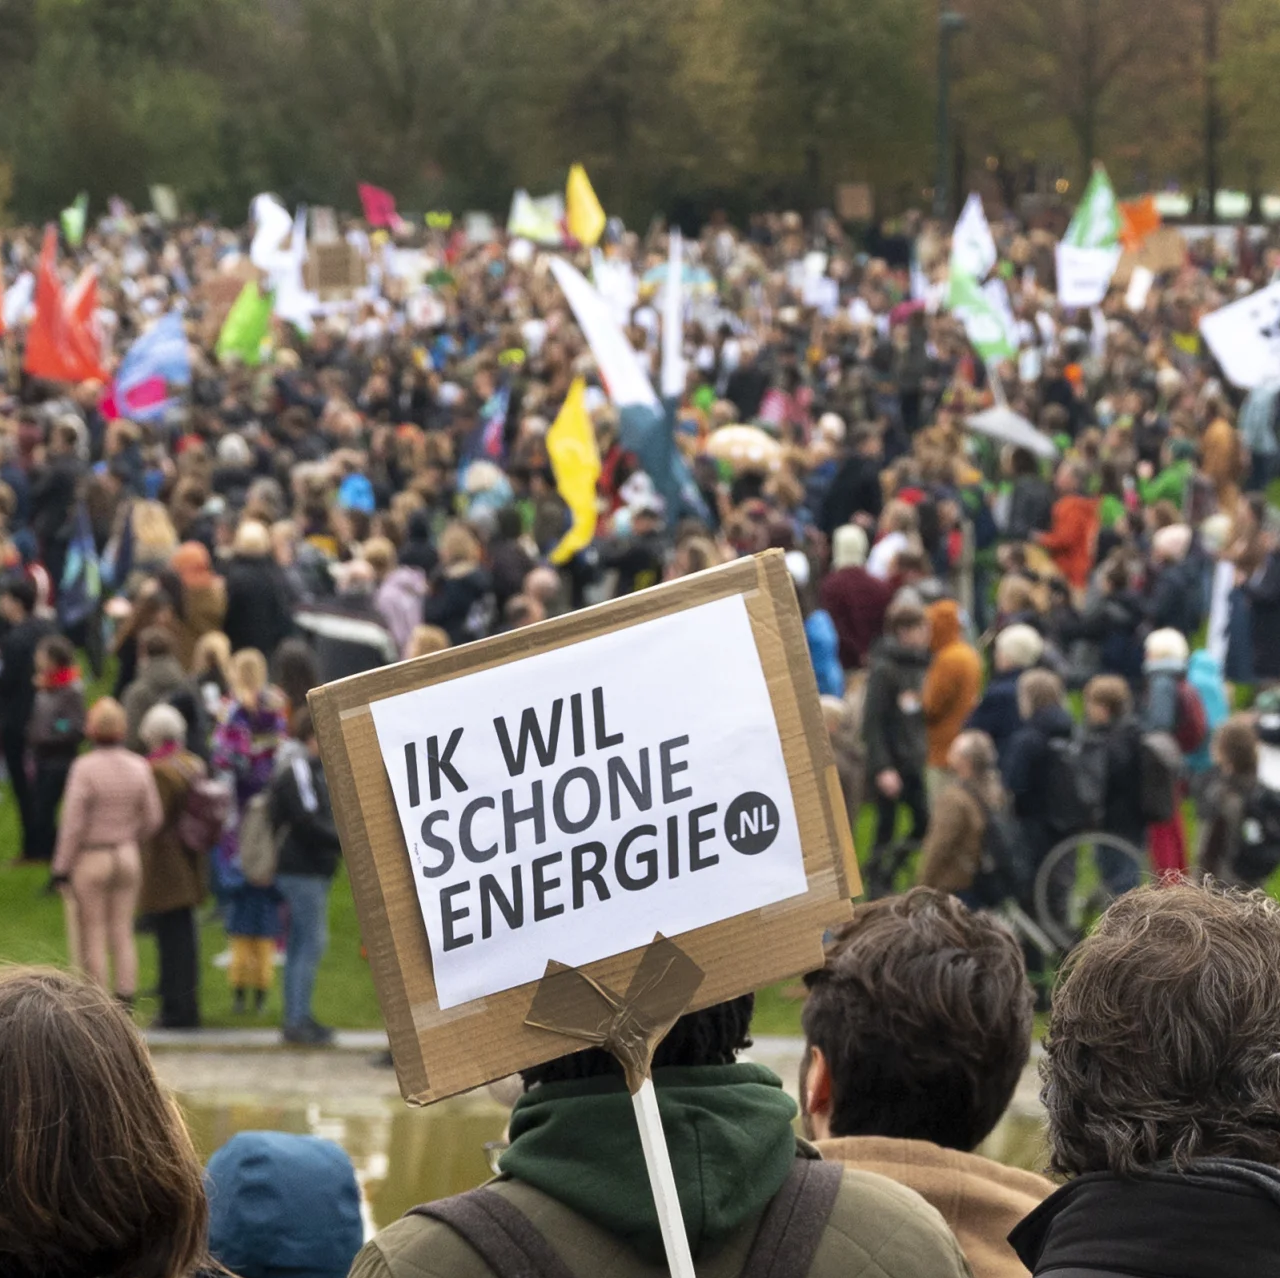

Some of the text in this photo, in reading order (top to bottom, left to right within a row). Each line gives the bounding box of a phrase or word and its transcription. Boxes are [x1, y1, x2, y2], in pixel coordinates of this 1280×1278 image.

[404, 686, 625, 807] IK WIL
[420, 734, 693, 879] SCHONE
[439, 802, 720, 952] ENERGIE
